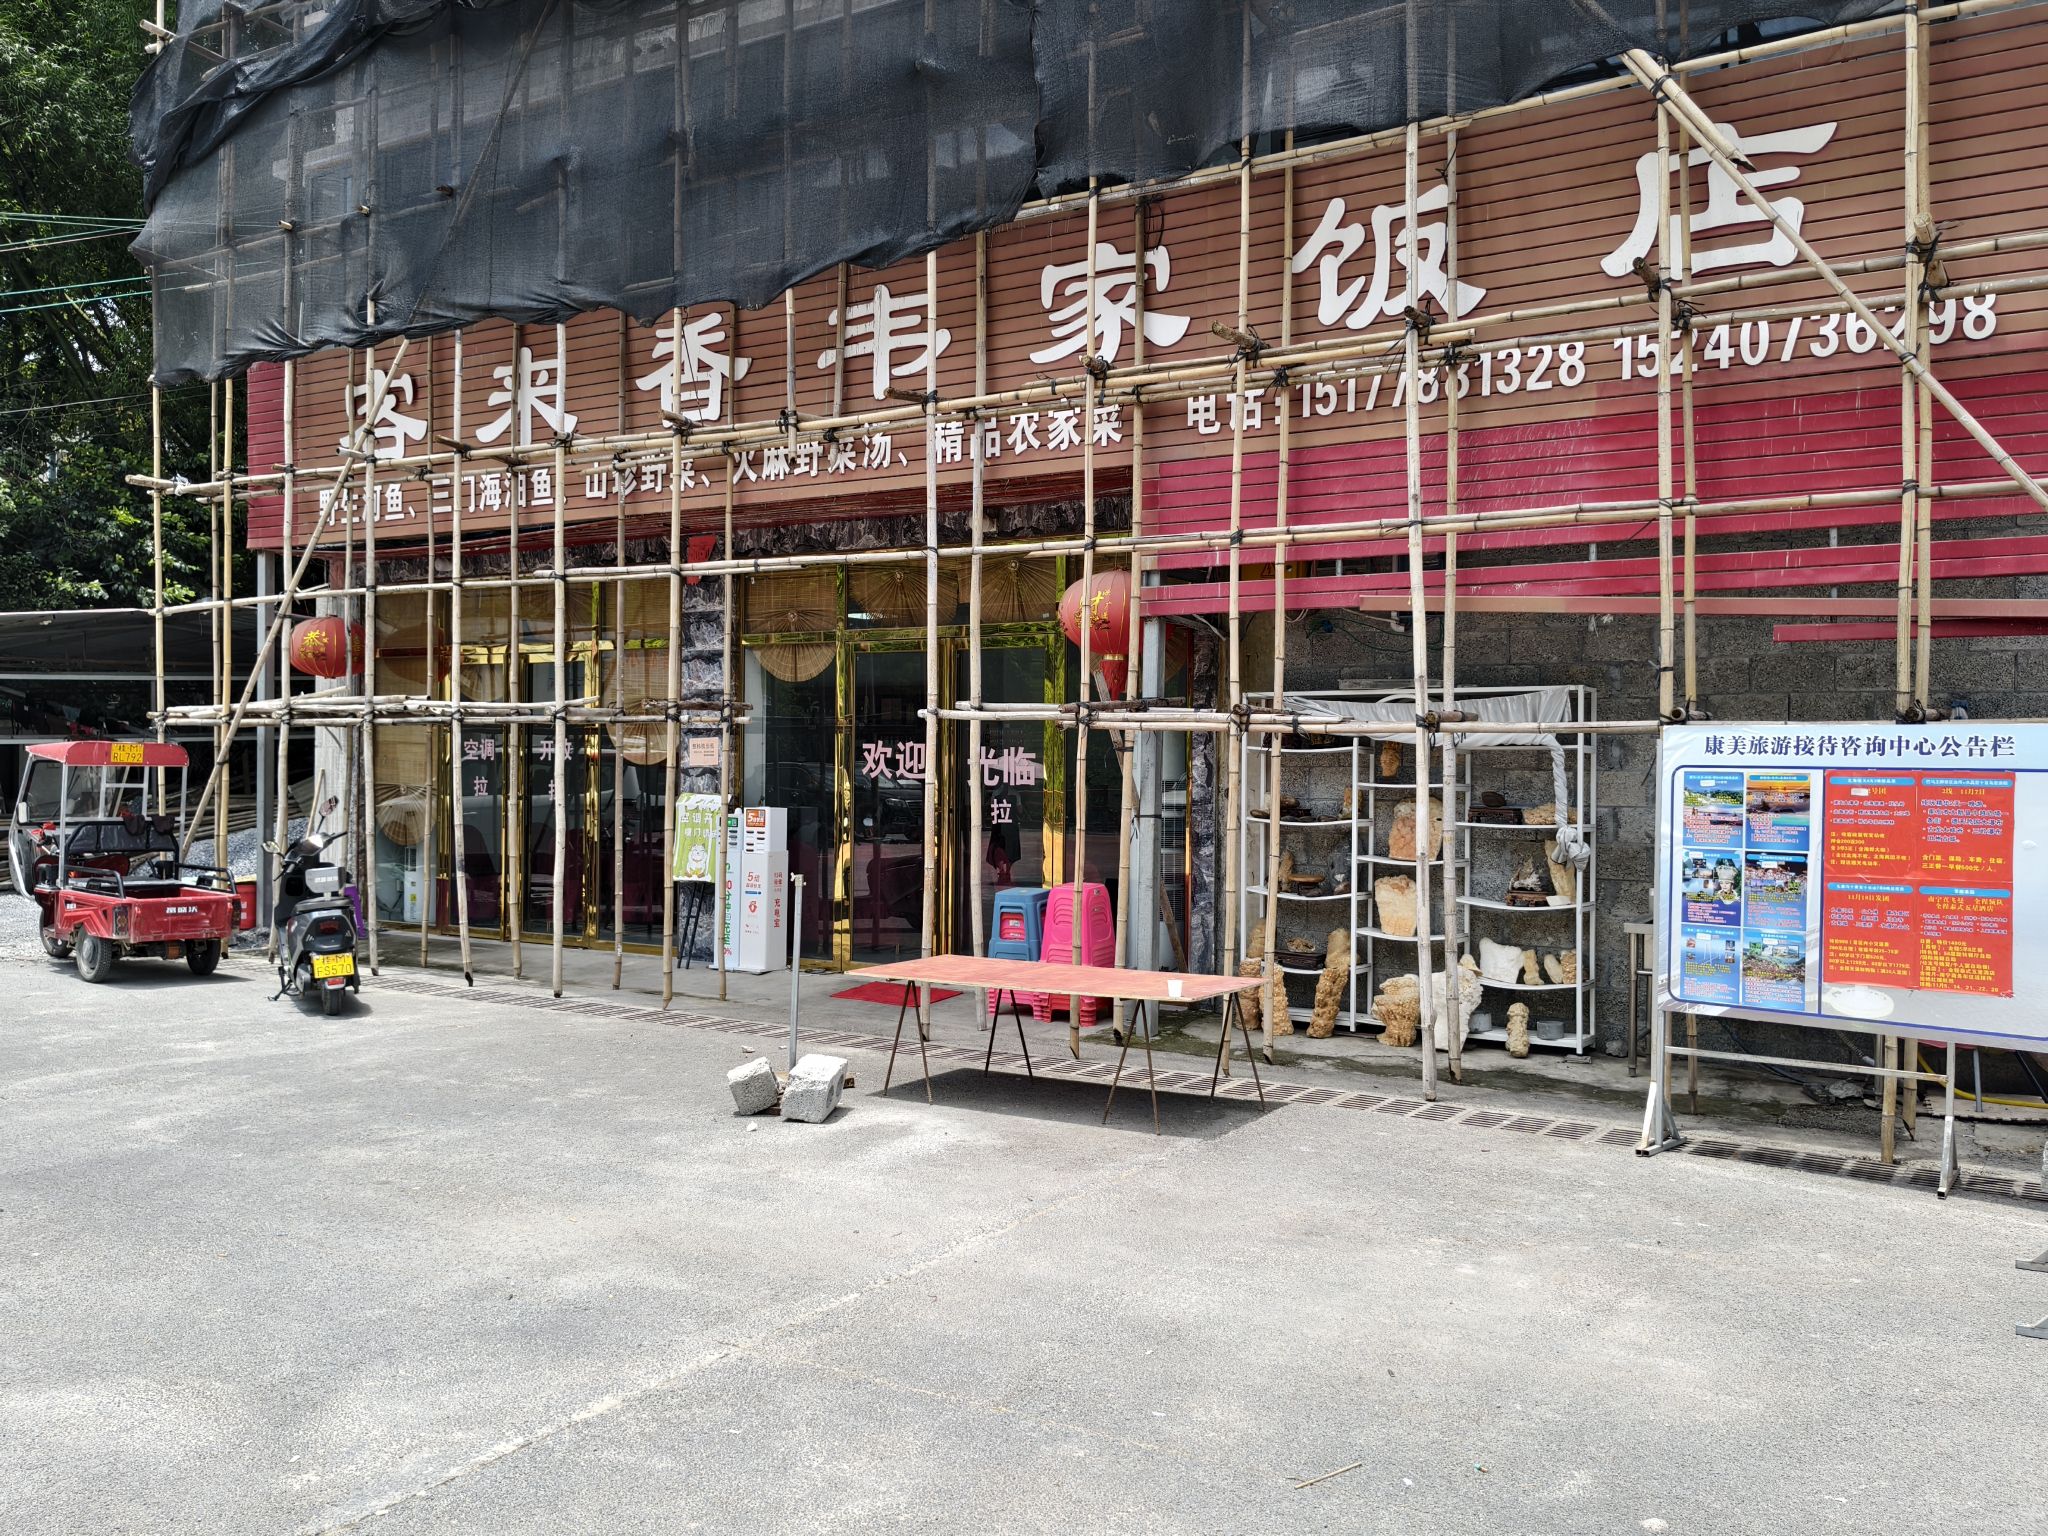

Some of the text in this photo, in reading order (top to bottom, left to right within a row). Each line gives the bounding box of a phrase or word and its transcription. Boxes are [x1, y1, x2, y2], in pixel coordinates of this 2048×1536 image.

[464, 739, 495, 760] 空调
[1703, 734, 2016, 757] 康美旅游接待咨询中心公告栏
[113, 752, 142, 762] RL792
[862, 740, 1036, 786] 欢迎 光临
[474, 775, 489, 797] 拉
[990, 798, 1013, 825] 拉
[316, 963, 353, 977] FS570
